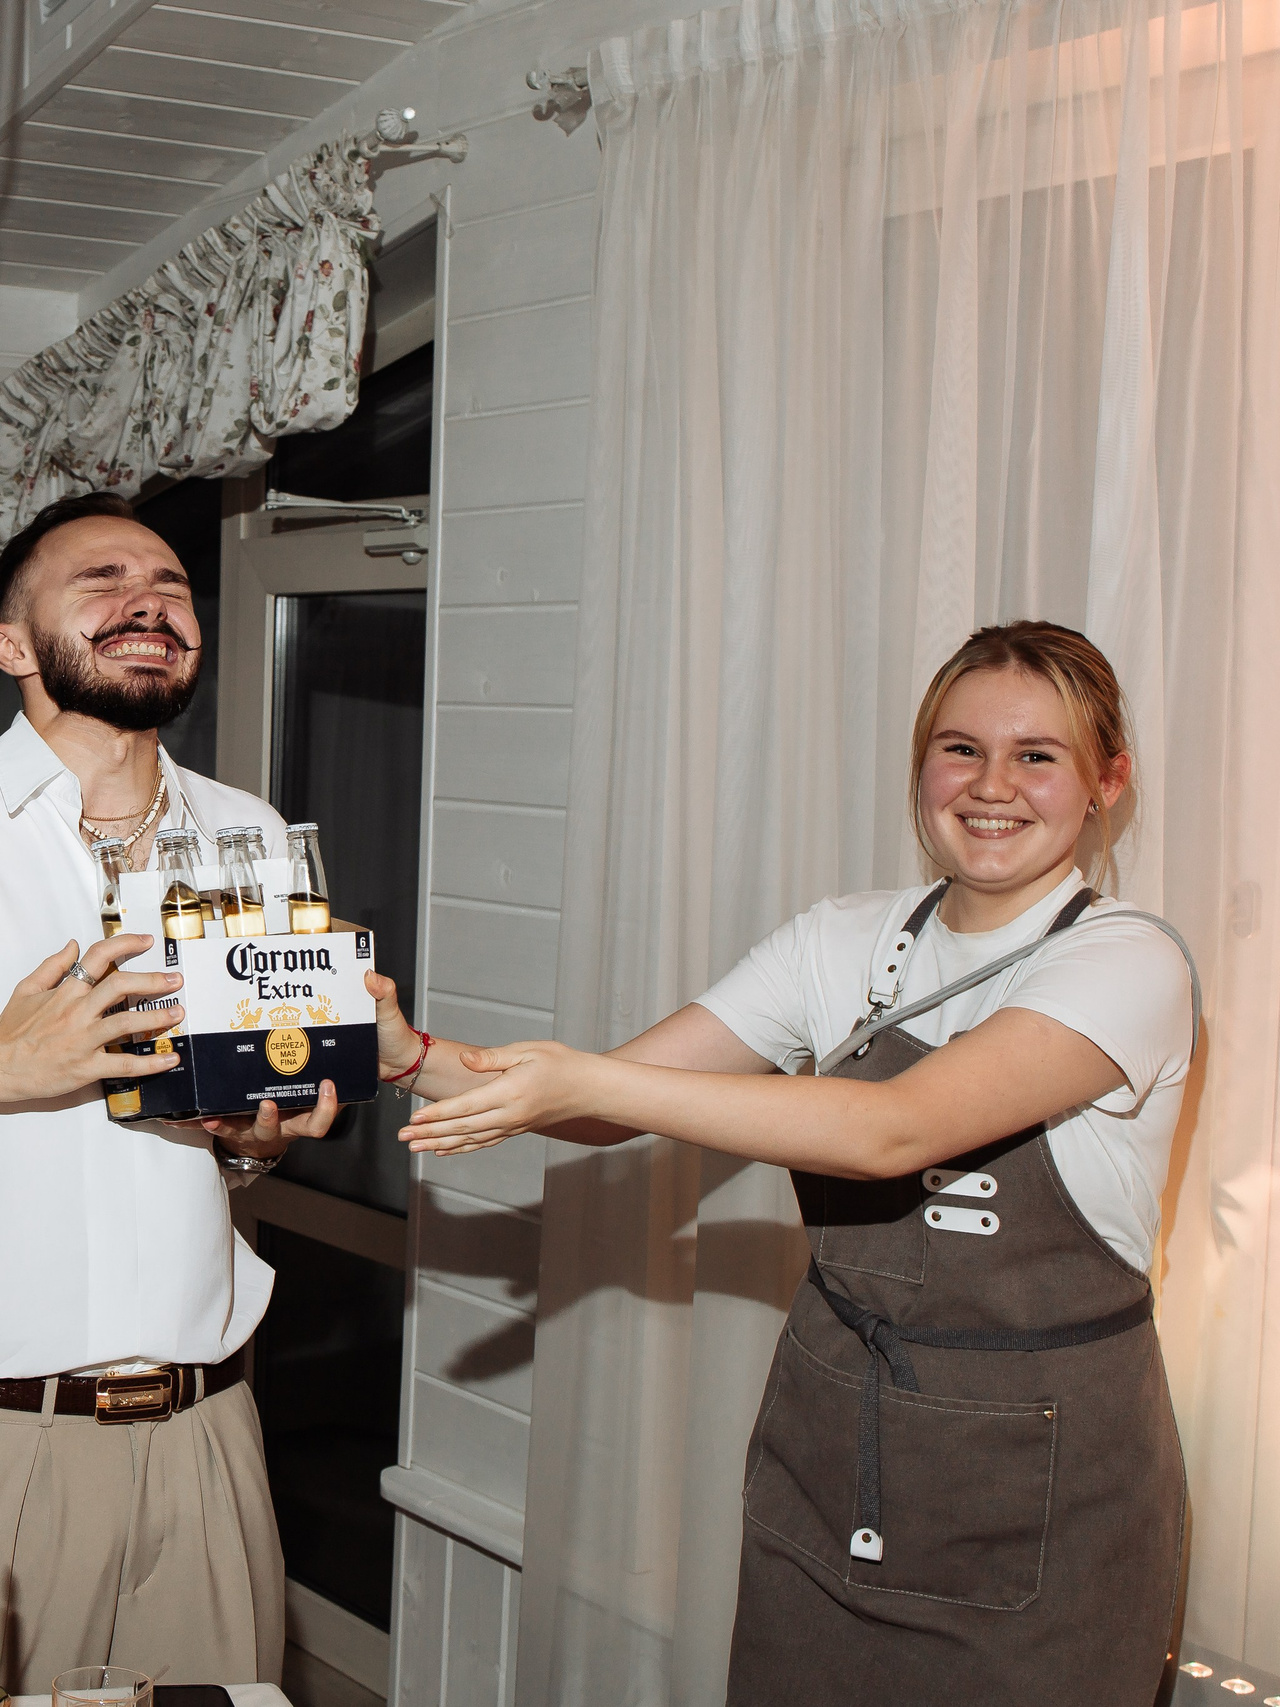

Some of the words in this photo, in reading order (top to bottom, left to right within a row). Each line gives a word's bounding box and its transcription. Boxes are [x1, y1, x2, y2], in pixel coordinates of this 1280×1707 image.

[360, 936, 366, 948] 6
[168, 943, 174, 955] 6
[226, 942, 333, 985] Corona
[256, 975, 314, 1000] Extra
[270, 1041, 305, 1050] CERVEZA
[321, 1039, 336, 1047] 1925
[236, 1044, 255, 1053] SINCE
[280, 1050, 297, 1058] MAS
[280, 1058, 298, 1066] FINA
[246, 1092, 276, 1100] CERVECERIA
